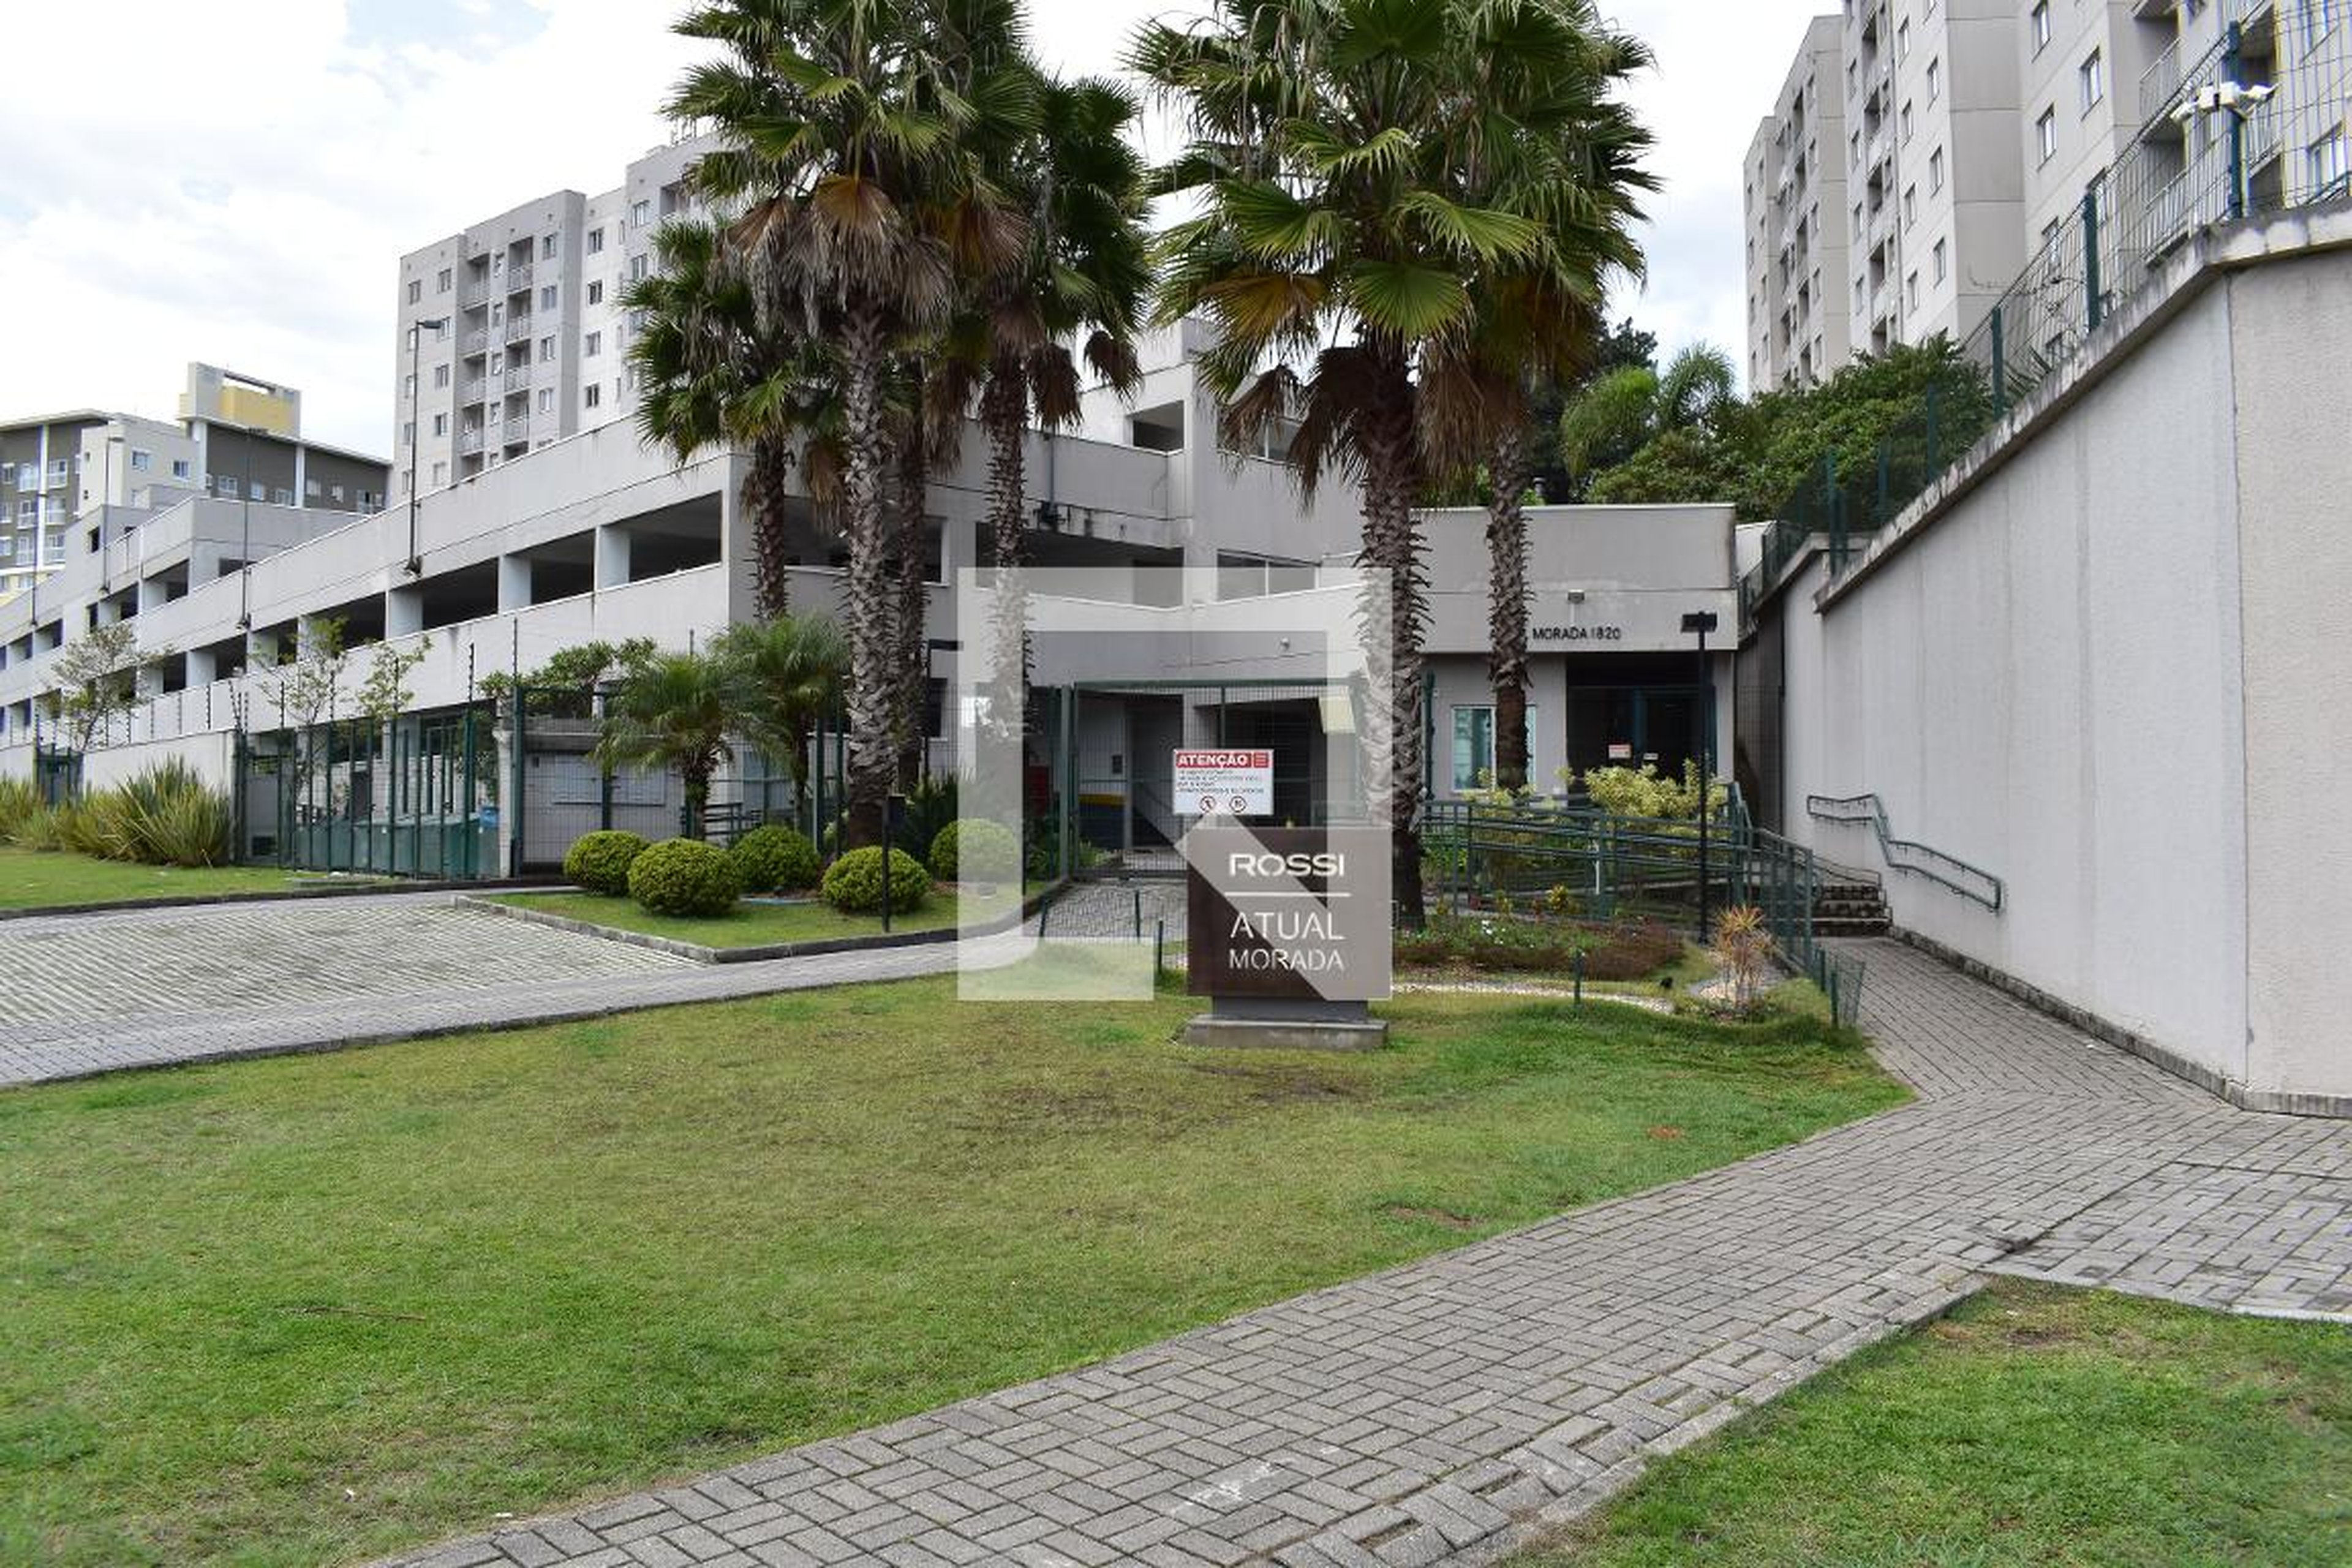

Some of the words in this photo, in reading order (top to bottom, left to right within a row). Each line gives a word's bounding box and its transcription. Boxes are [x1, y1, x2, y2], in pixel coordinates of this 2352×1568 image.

[1532, 627, 1587, 640] MORADA
[1592, 627, 1621, 640] 1820
[1177, 751, 1248, 768] ATENÇÃO
[1229, 853, 1346, 877] ROSSI
[1229, 911, 1347, 940] ATUAL
[1229, 948, 1346, 970] MORADA
